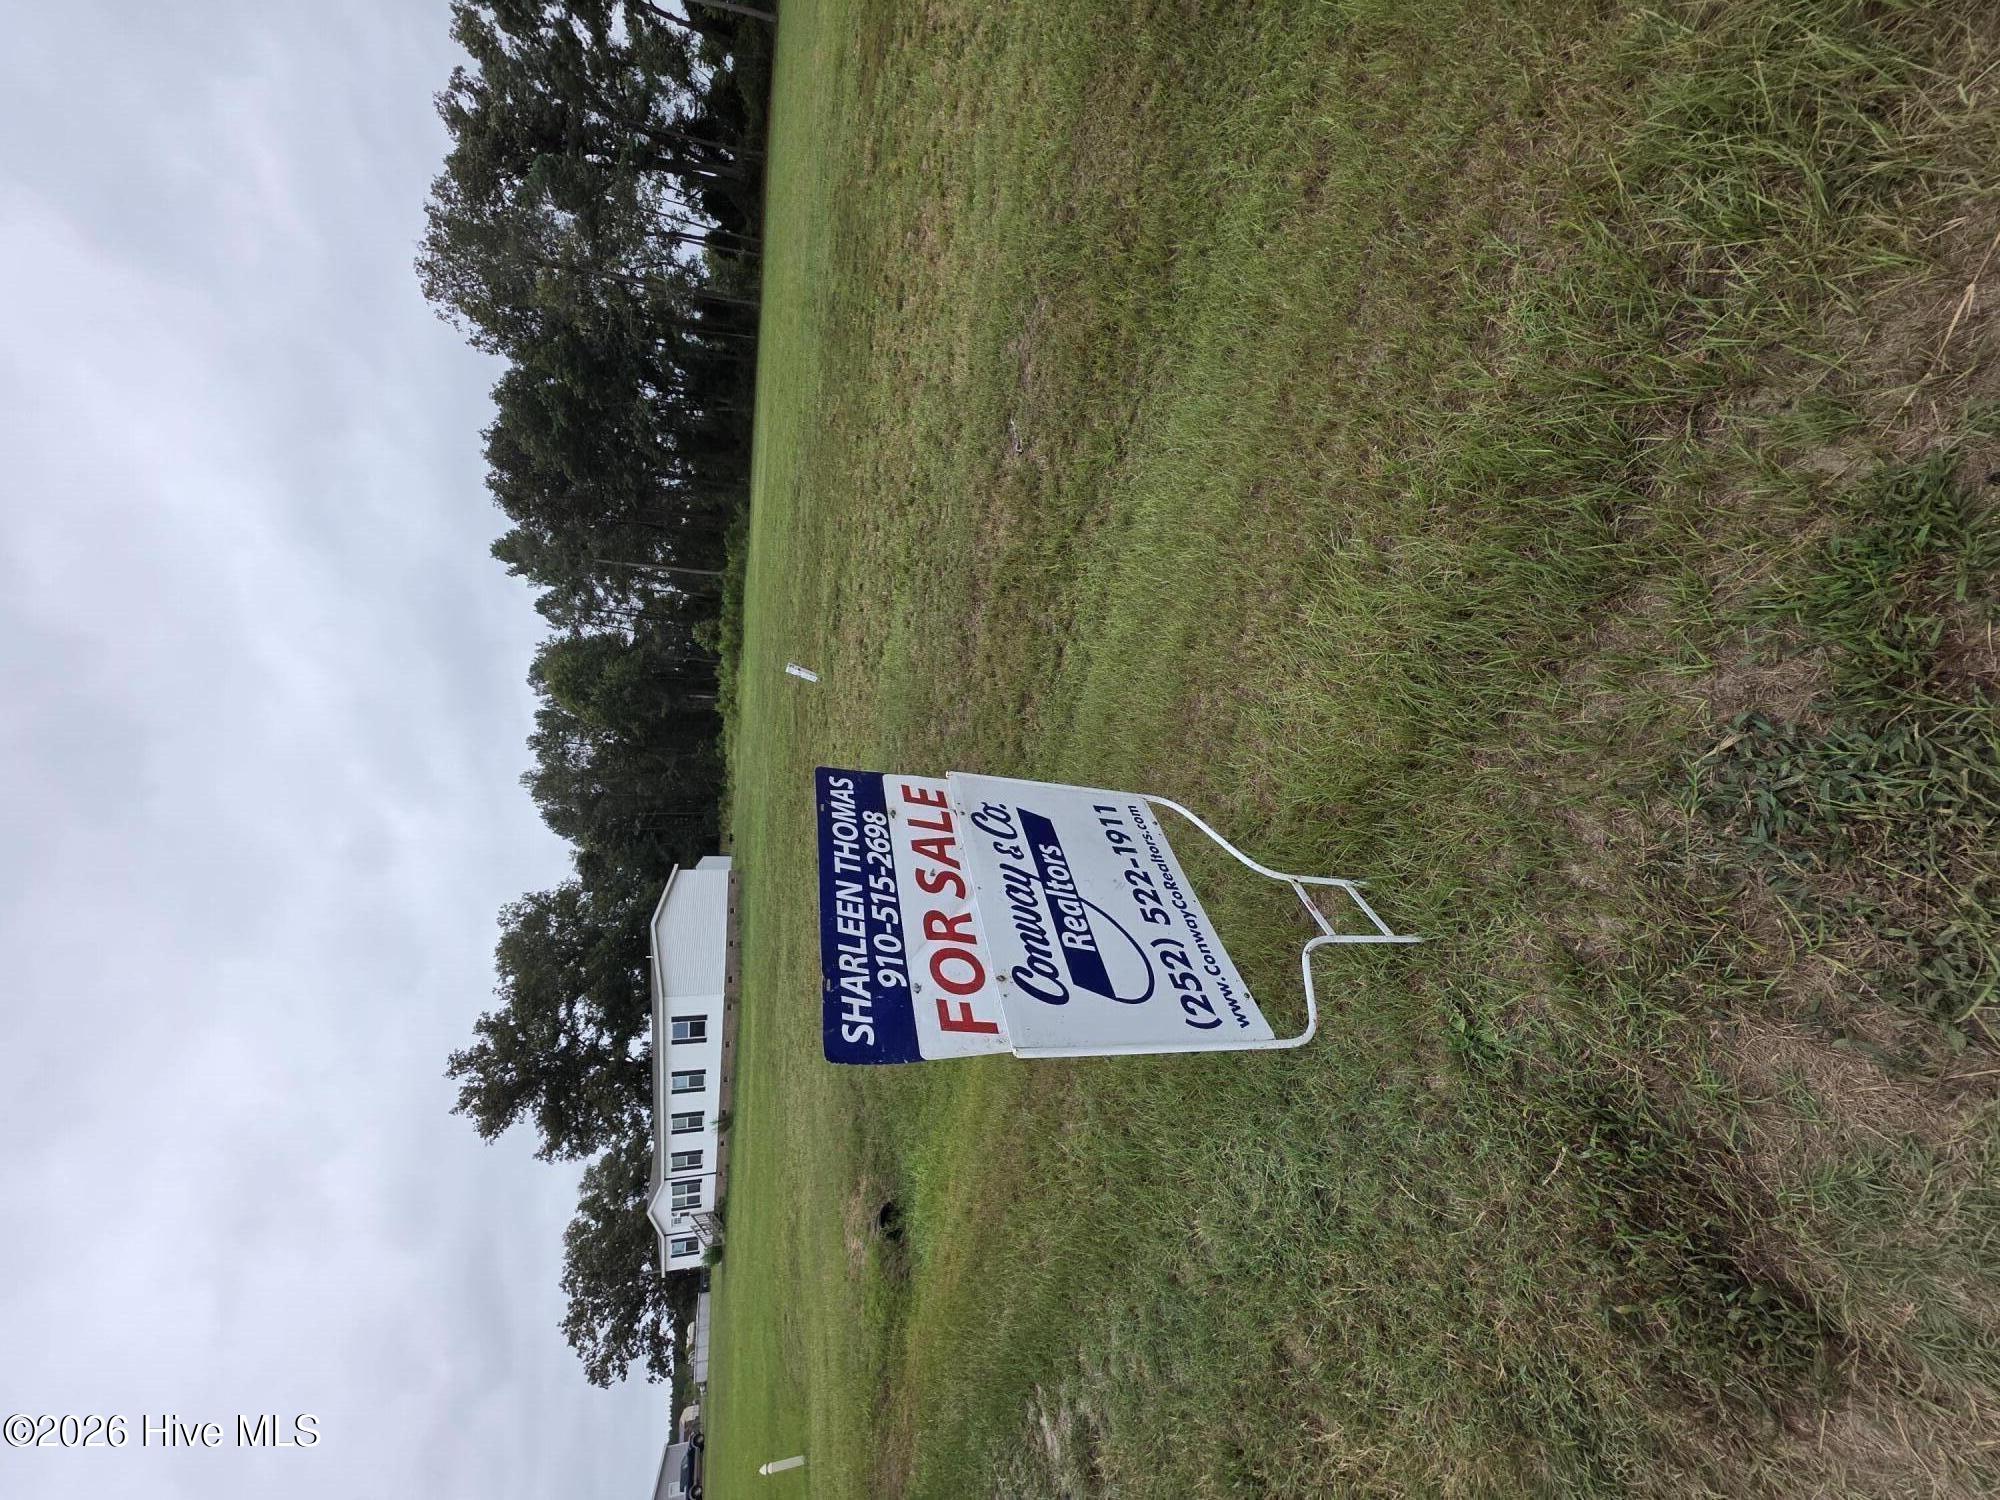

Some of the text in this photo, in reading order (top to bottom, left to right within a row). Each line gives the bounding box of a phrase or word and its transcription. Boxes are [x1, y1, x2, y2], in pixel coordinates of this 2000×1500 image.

[829, 776, 874, 1045] SHARLEEN THOMAS
[863, 810, 907, 988] 910-515-2698
[901, 784, 999, 1034] FOR SALE
[994, 841, 1025, 860] &
[1000, 863, 1070, 1005] Conway
[1039, 843, 1097, 951] Realtors
[1093, 804, 1223, 1030] (252) 522-1911
